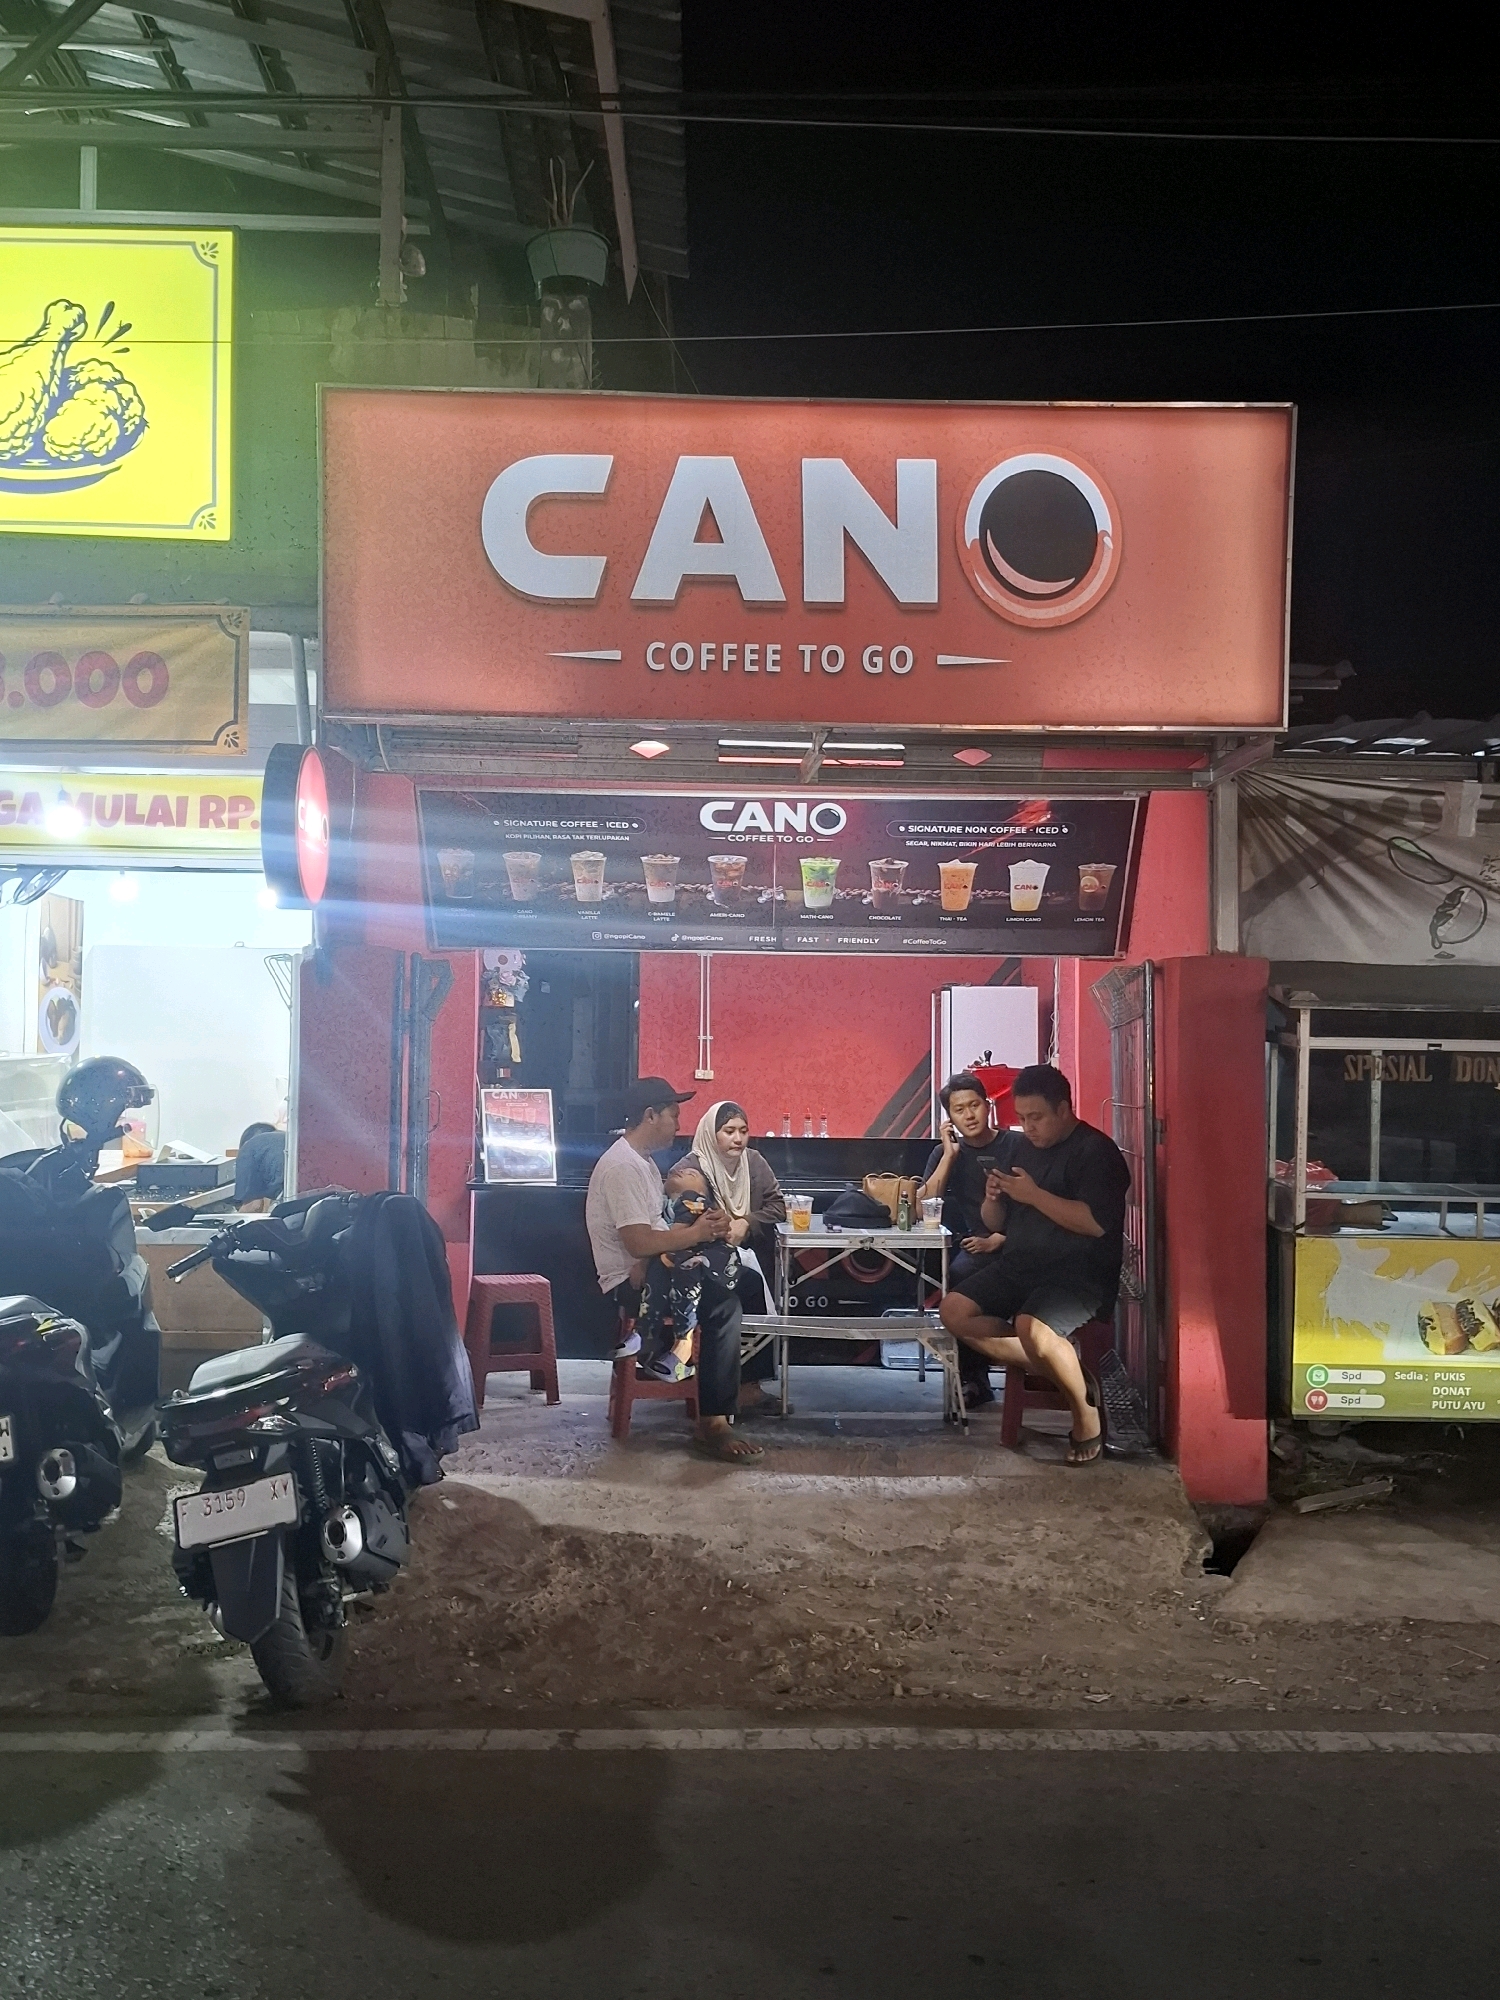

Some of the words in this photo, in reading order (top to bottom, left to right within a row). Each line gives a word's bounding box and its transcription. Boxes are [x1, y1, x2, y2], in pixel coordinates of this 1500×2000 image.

[481, 452, 1118, 622] CANO
[645, 641, 781, 674] COFFEE
[798, 644, 845, 674] TO
[861, 645, 914, 675] GO
[0, 650, 169, 709] .000
[503, 819, 558, 828] SIGNATURE
[559, 820, 599, 829] COFFEE
[605, 821, 629, 829] ICED
[700, 801, 847, 836] CANO
[908, 825, 963, 834] SIGNATURE
[964, 826, 988, 834] NON
[989, 826, 1027, 834] COFFEE
[586, 834, 630, 842] TERLUPAKAN
[727, 834, 774, 843] COFFEE
[777, 835, 793, 843] TO
[795, 835, 814, 843] GO
[748, 935, 778, 943] FRESH
[1343, 1054, 1433, 1082] SPESIAL
[805, 1295, 828, 1308] GO
[1341, 1371, 1362, 1381] Spd
[1434, 1372, 1466, 1382] PUKIS
[1432, 1386, 1472, 1397] DONAT
[1340, 1396, 1361, 1405] Spd
[1431, 1400, 1461, 1411] PUTU
[1463, 1401, 1485, 1411] AYU
[201, 1487, 247, 1518] 3159
